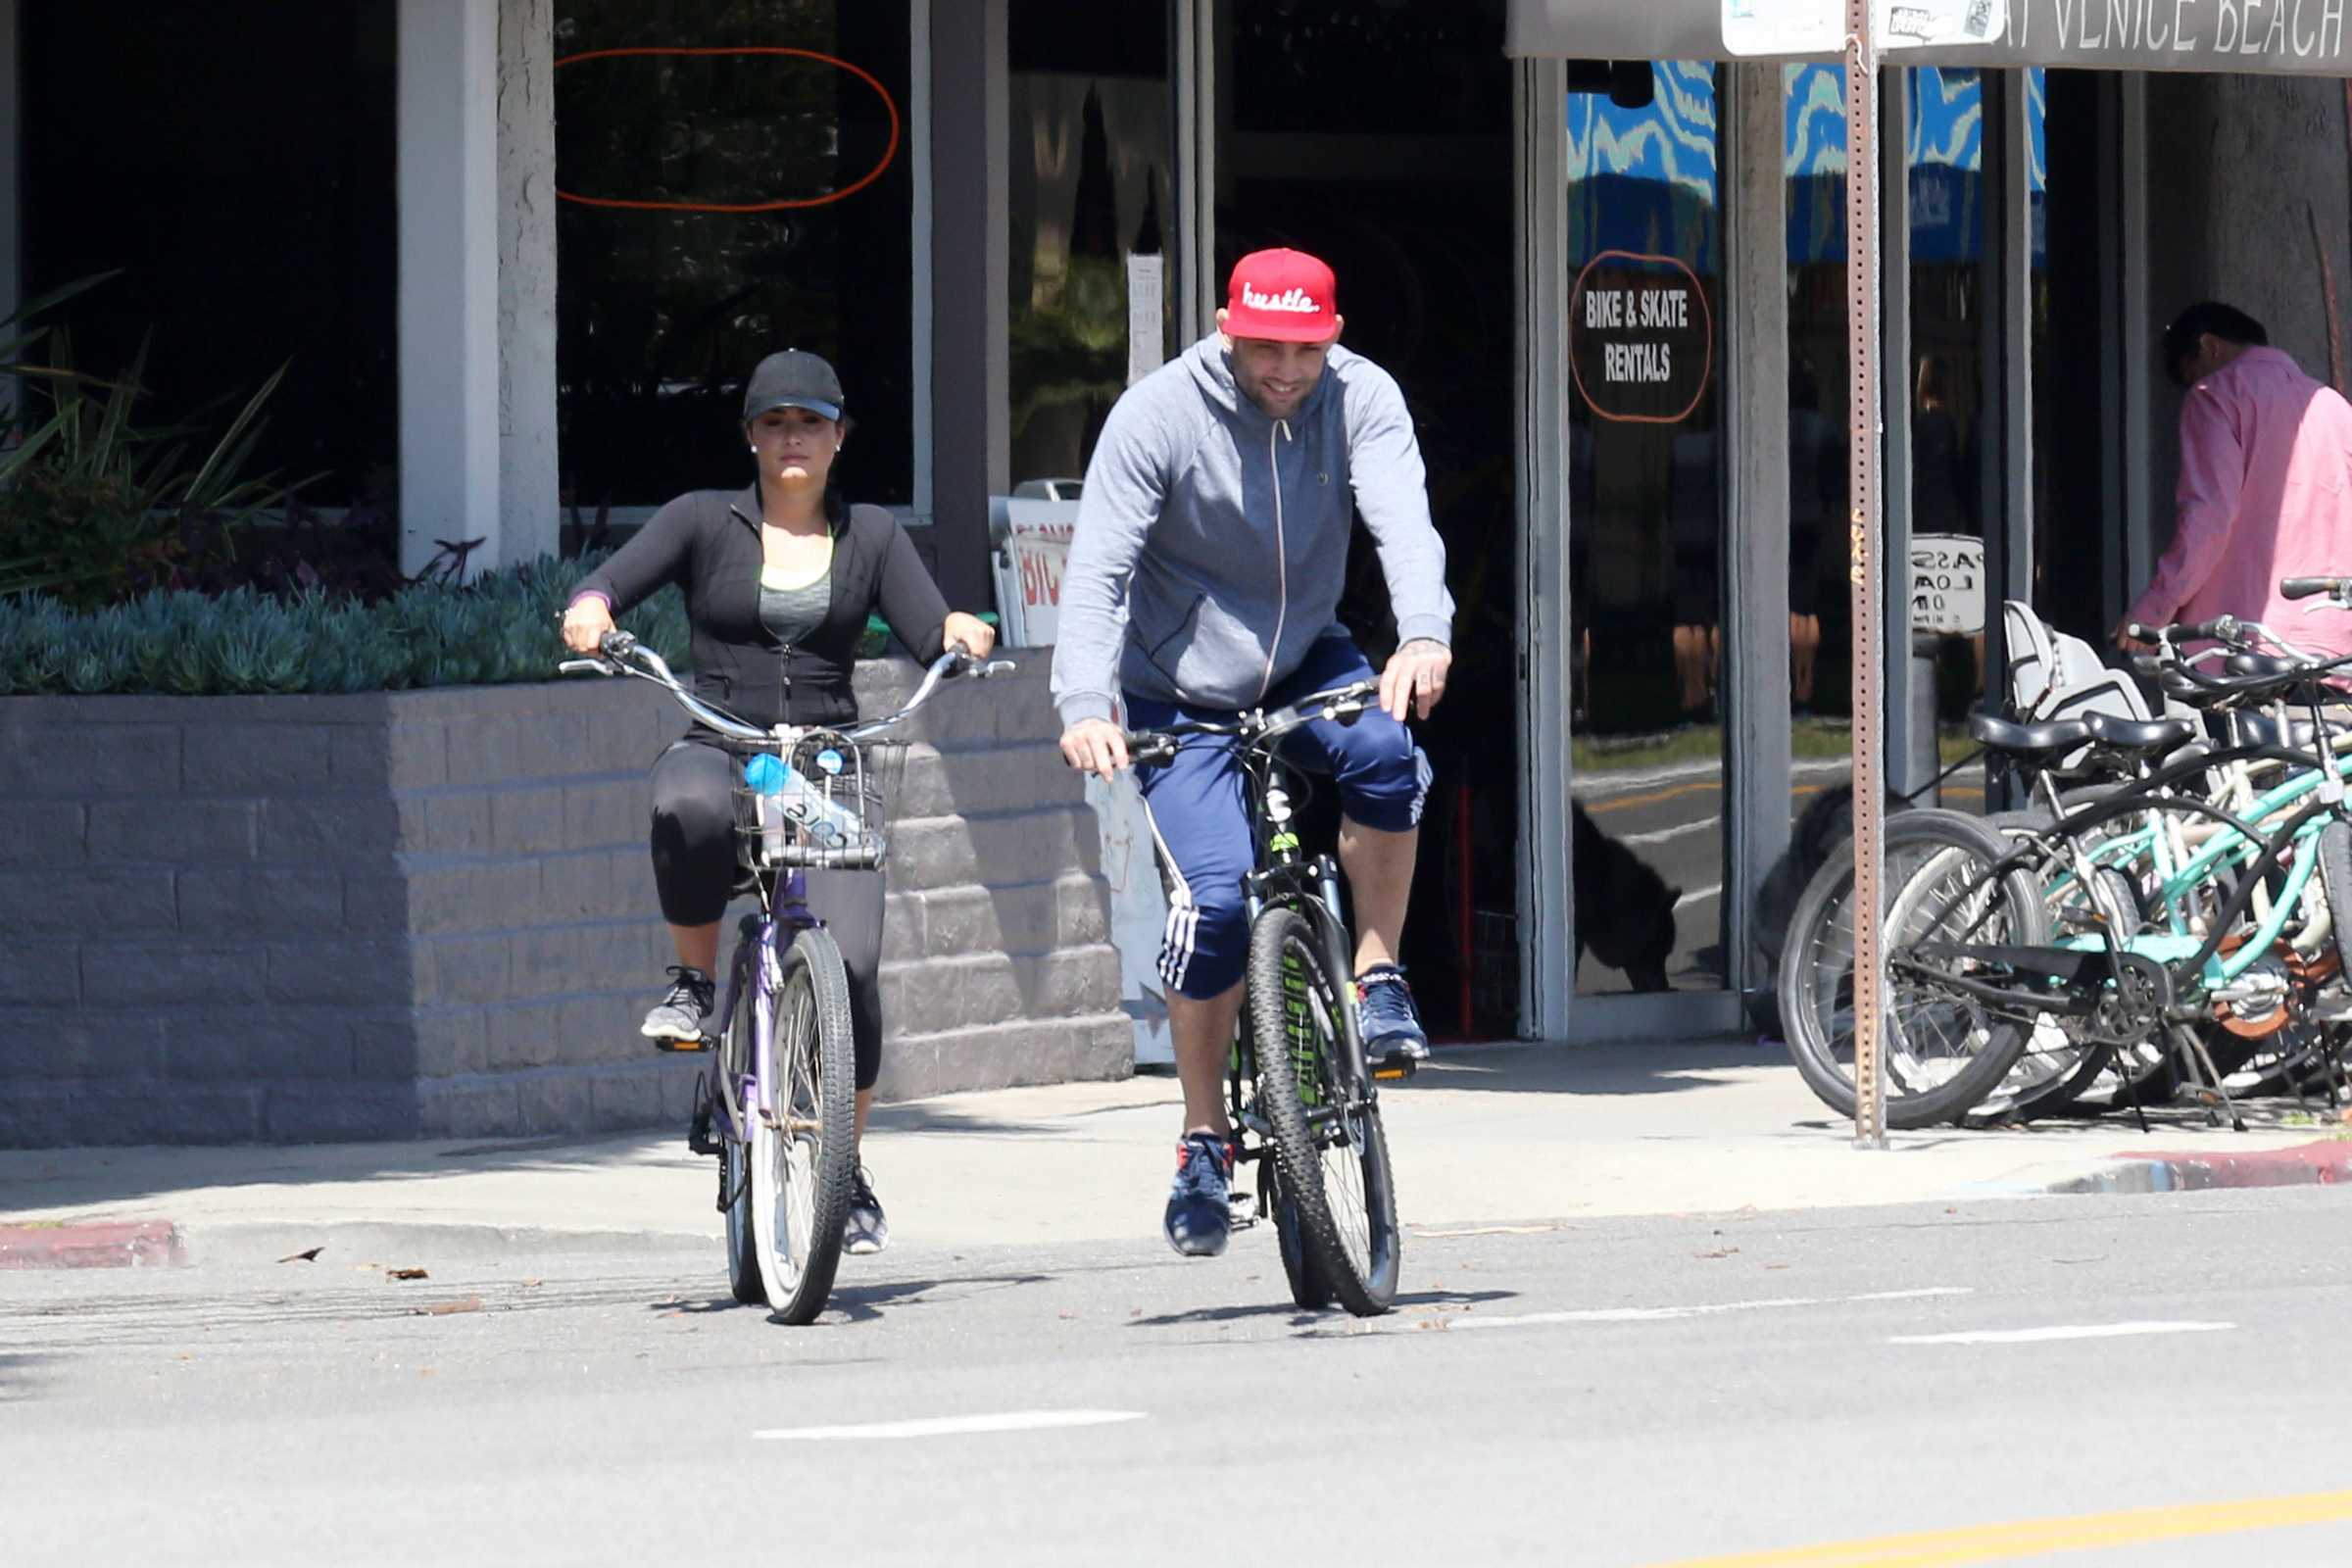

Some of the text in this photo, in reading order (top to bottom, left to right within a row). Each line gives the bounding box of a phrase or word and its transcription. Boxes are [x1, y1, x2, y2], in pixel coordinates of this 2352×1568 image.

[2213, 0, 2344, 59] BEACH
[1586, 290, 1689, 329] BIKE & SKATE
[1604, 342, 1671, 382] RENTALS
